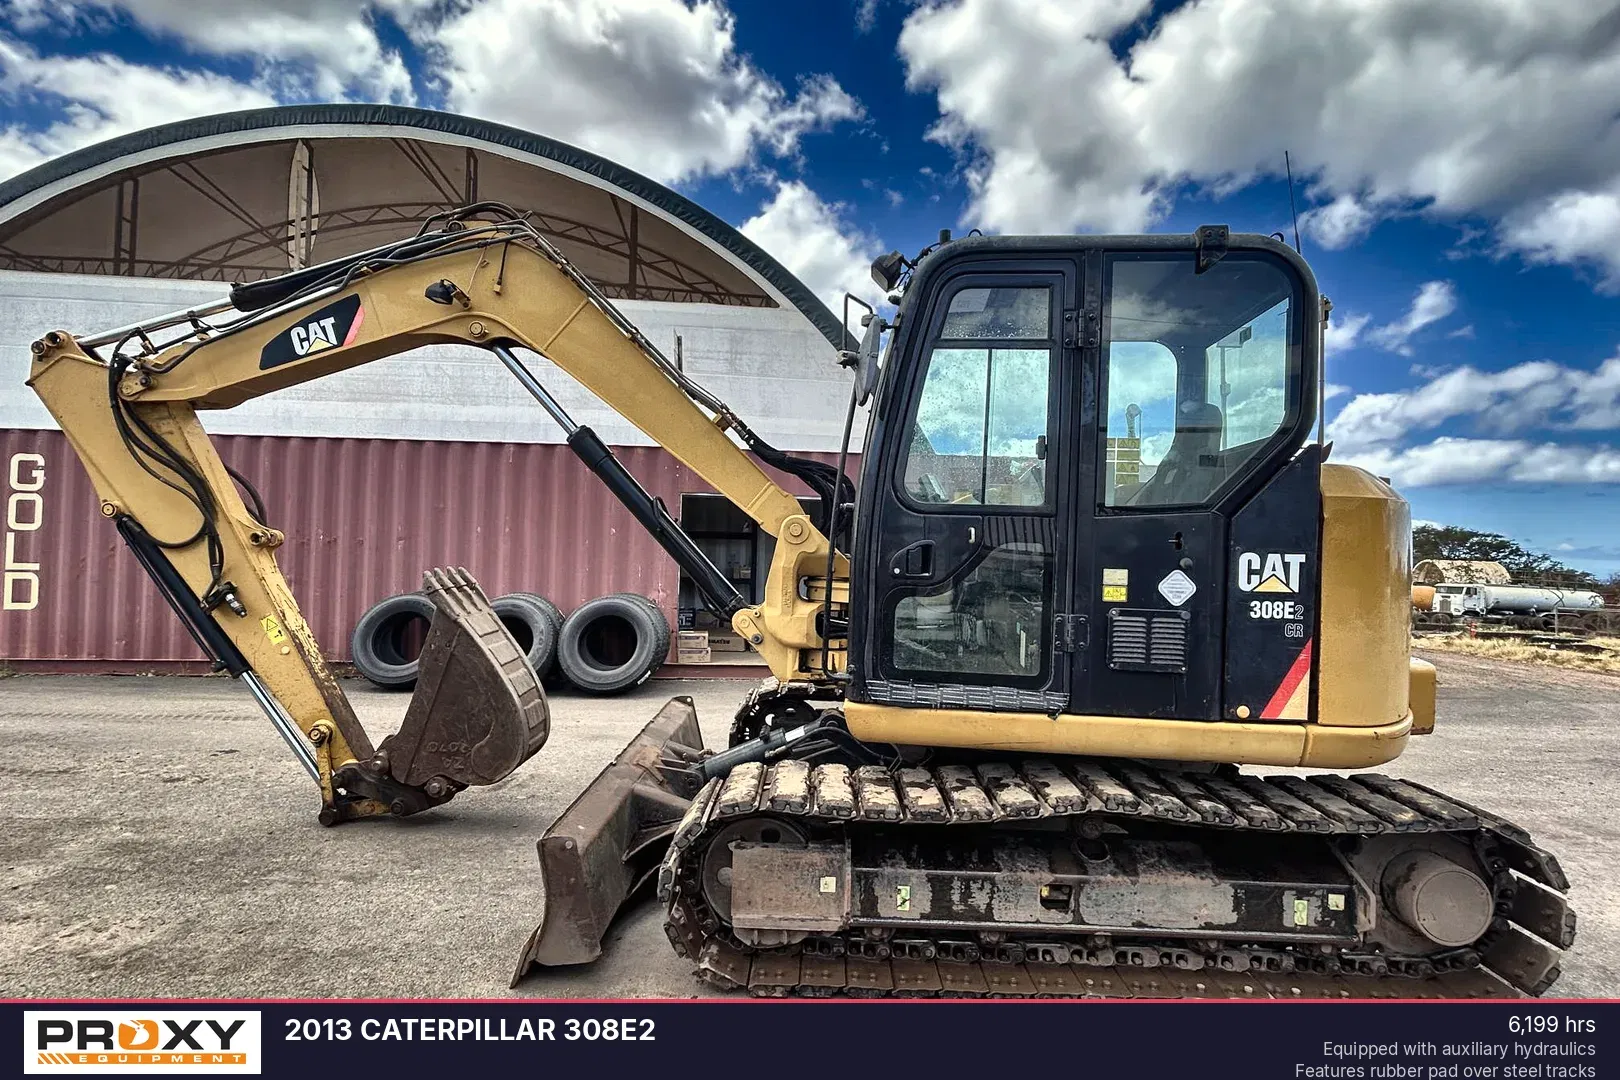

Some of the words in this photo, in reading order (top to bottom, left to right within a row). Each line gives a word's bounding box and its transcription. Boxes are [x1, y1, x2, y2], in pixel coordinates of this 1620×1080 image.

[290, 317, 336, 356] CAT
[3, 453, 46, 611] GOLD
[1238, 552, 1306, 593] CAT
[1250, 601, 1304, 620] 308E2
[1284, 623, 1304, 638] CR
